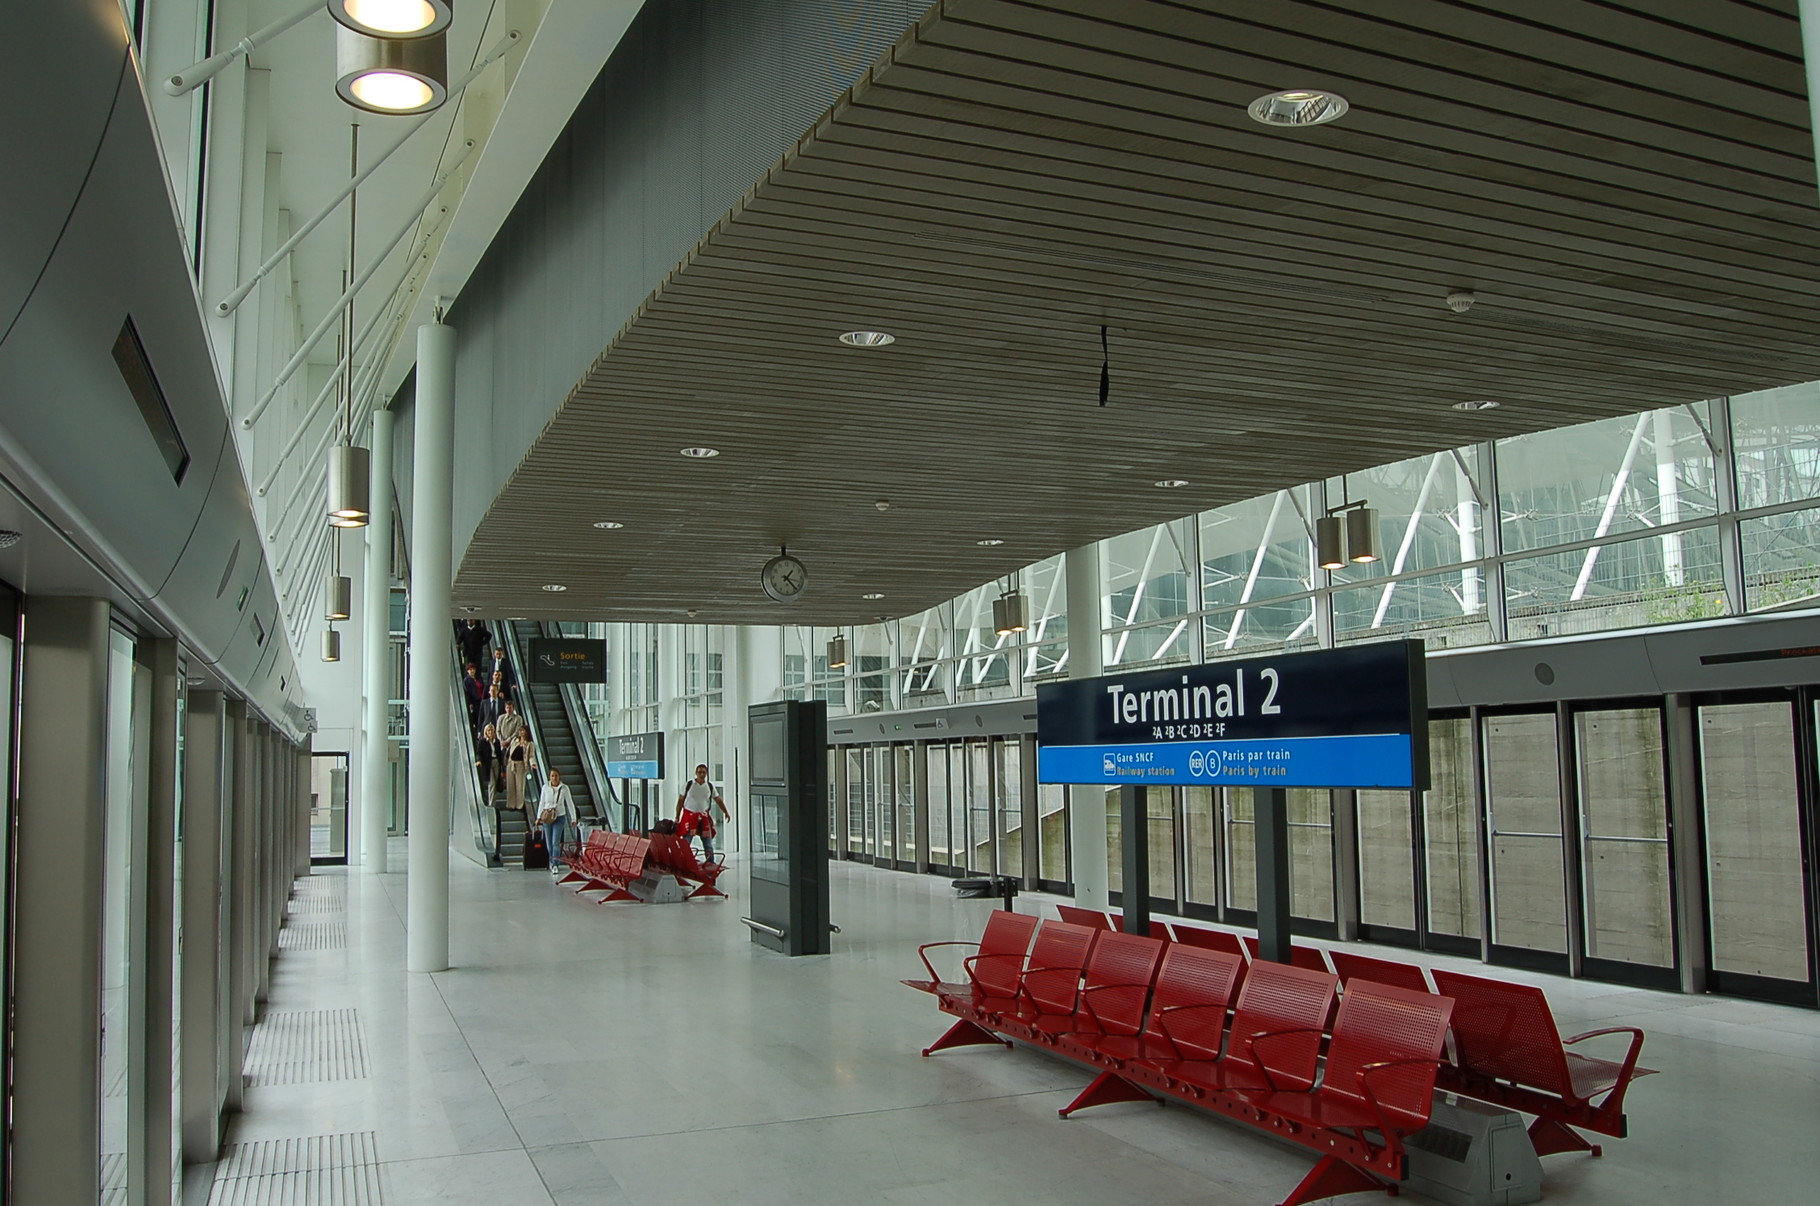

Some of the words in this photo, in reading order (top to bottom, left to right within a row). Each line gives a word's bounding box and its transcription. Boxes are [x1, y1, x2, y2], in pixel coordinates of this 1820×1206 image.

[560, 652, 586, 660] Sortie
[1107, 669, 1245, 724] Terminal
[1260, 668, 1281, 715] 2
[619, 736, 639, 754] Terminal
[640, 736, 644, 754] 2
[1116, 753, 1134, 763] Gare
[1135, 752, 1154, 763] SNCF
[1222, 750, 1245, 761] Paris
[1248, 751, 1263, 762] par
[1266, 748, 1290, 760] train
[1191, 758, 1203, 769] RER
[1210, 758, 1216, 769] B
[1117, 767, 1146, 778] Railway
[1147, 766, 1175, 776] station
[1223, 765, 1245, 776] Paris
[1248, 765, 1260, 779] by
[1263, 764, 1287, 776] train
